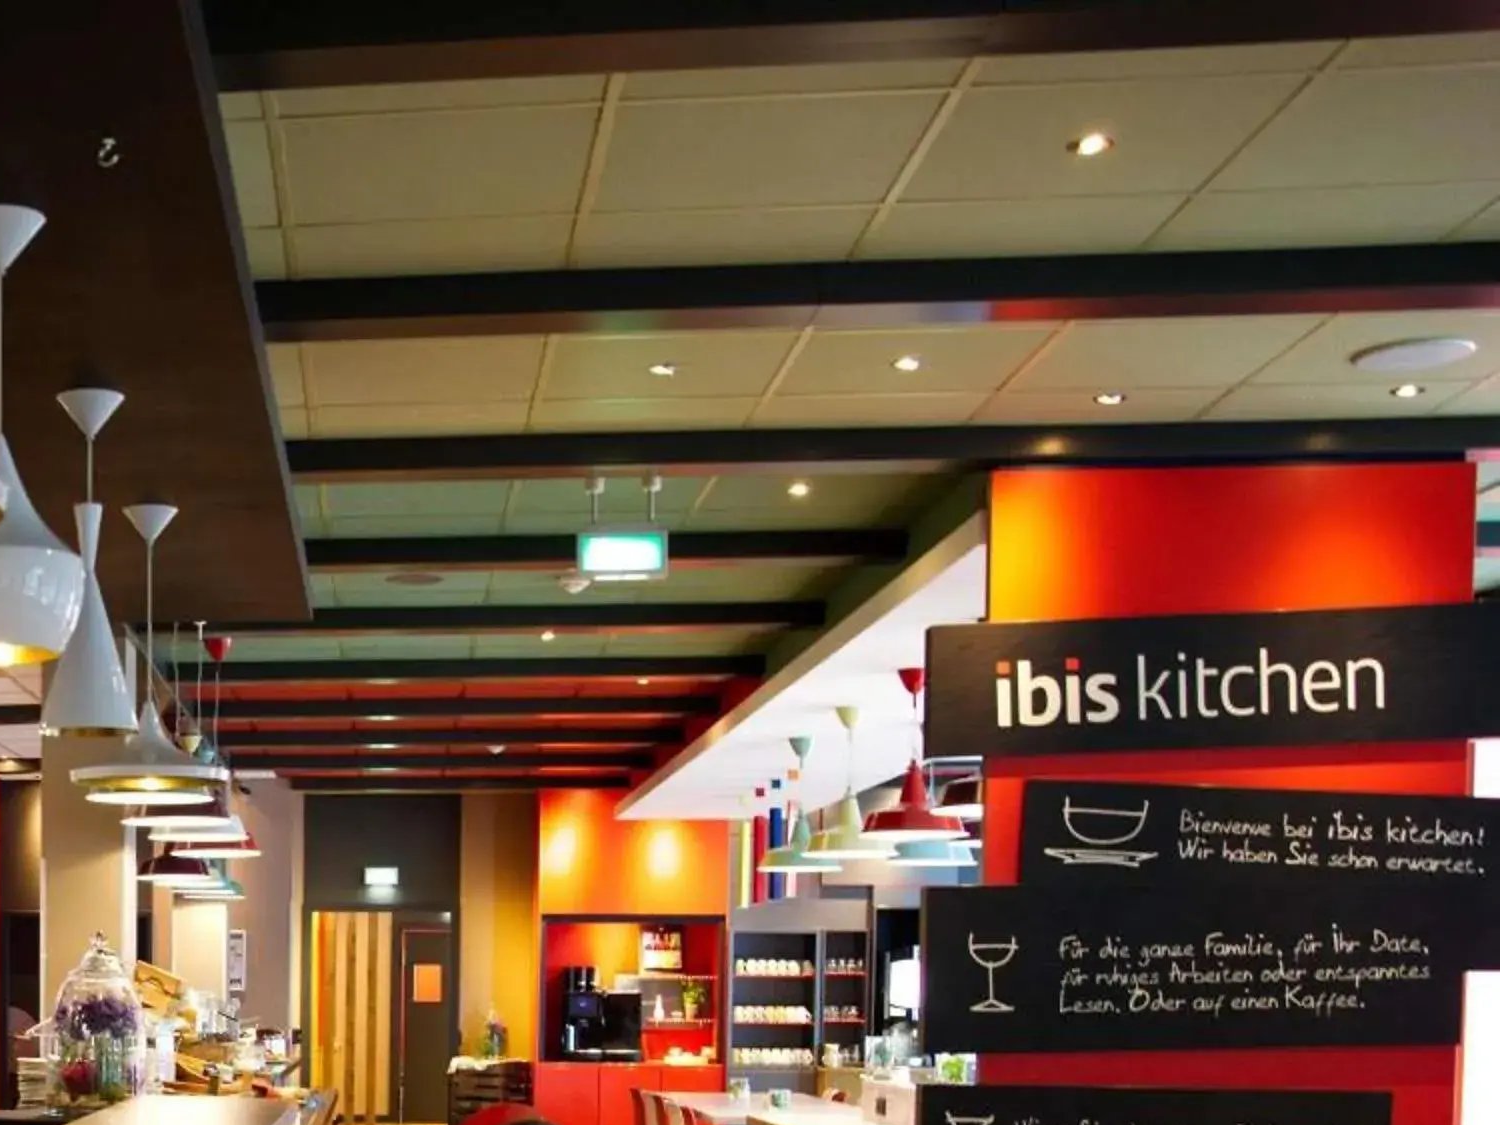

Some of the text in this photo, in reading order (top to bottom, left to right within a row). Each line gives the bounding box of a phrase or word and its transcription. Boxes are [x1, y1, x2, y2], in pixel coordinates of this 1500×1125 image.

[996, 647, 1386, 728] ibis kitchen
[1179, 808, 1485, 847] Bienvenue bei ibis kitchen!
[1177, 839, 1486, 875] Wir haben Sie schon erwartet.
[1059, 935, 1090, 960] Für
[1100, 936, 1131, 959] die
[1138, 943, 1195, 967] ganze
[1204, 931, 1283, 957] Familie,
[1293, 932, 1324, 962] für
[1369, 928, 1430, 956] Date,
[1060, 959, 1431, 991] für ruhiges Arbeiten oder entspanntes
[1059, 984, 1366, 1019] Lesen. Oder auf einen Kaffee.
